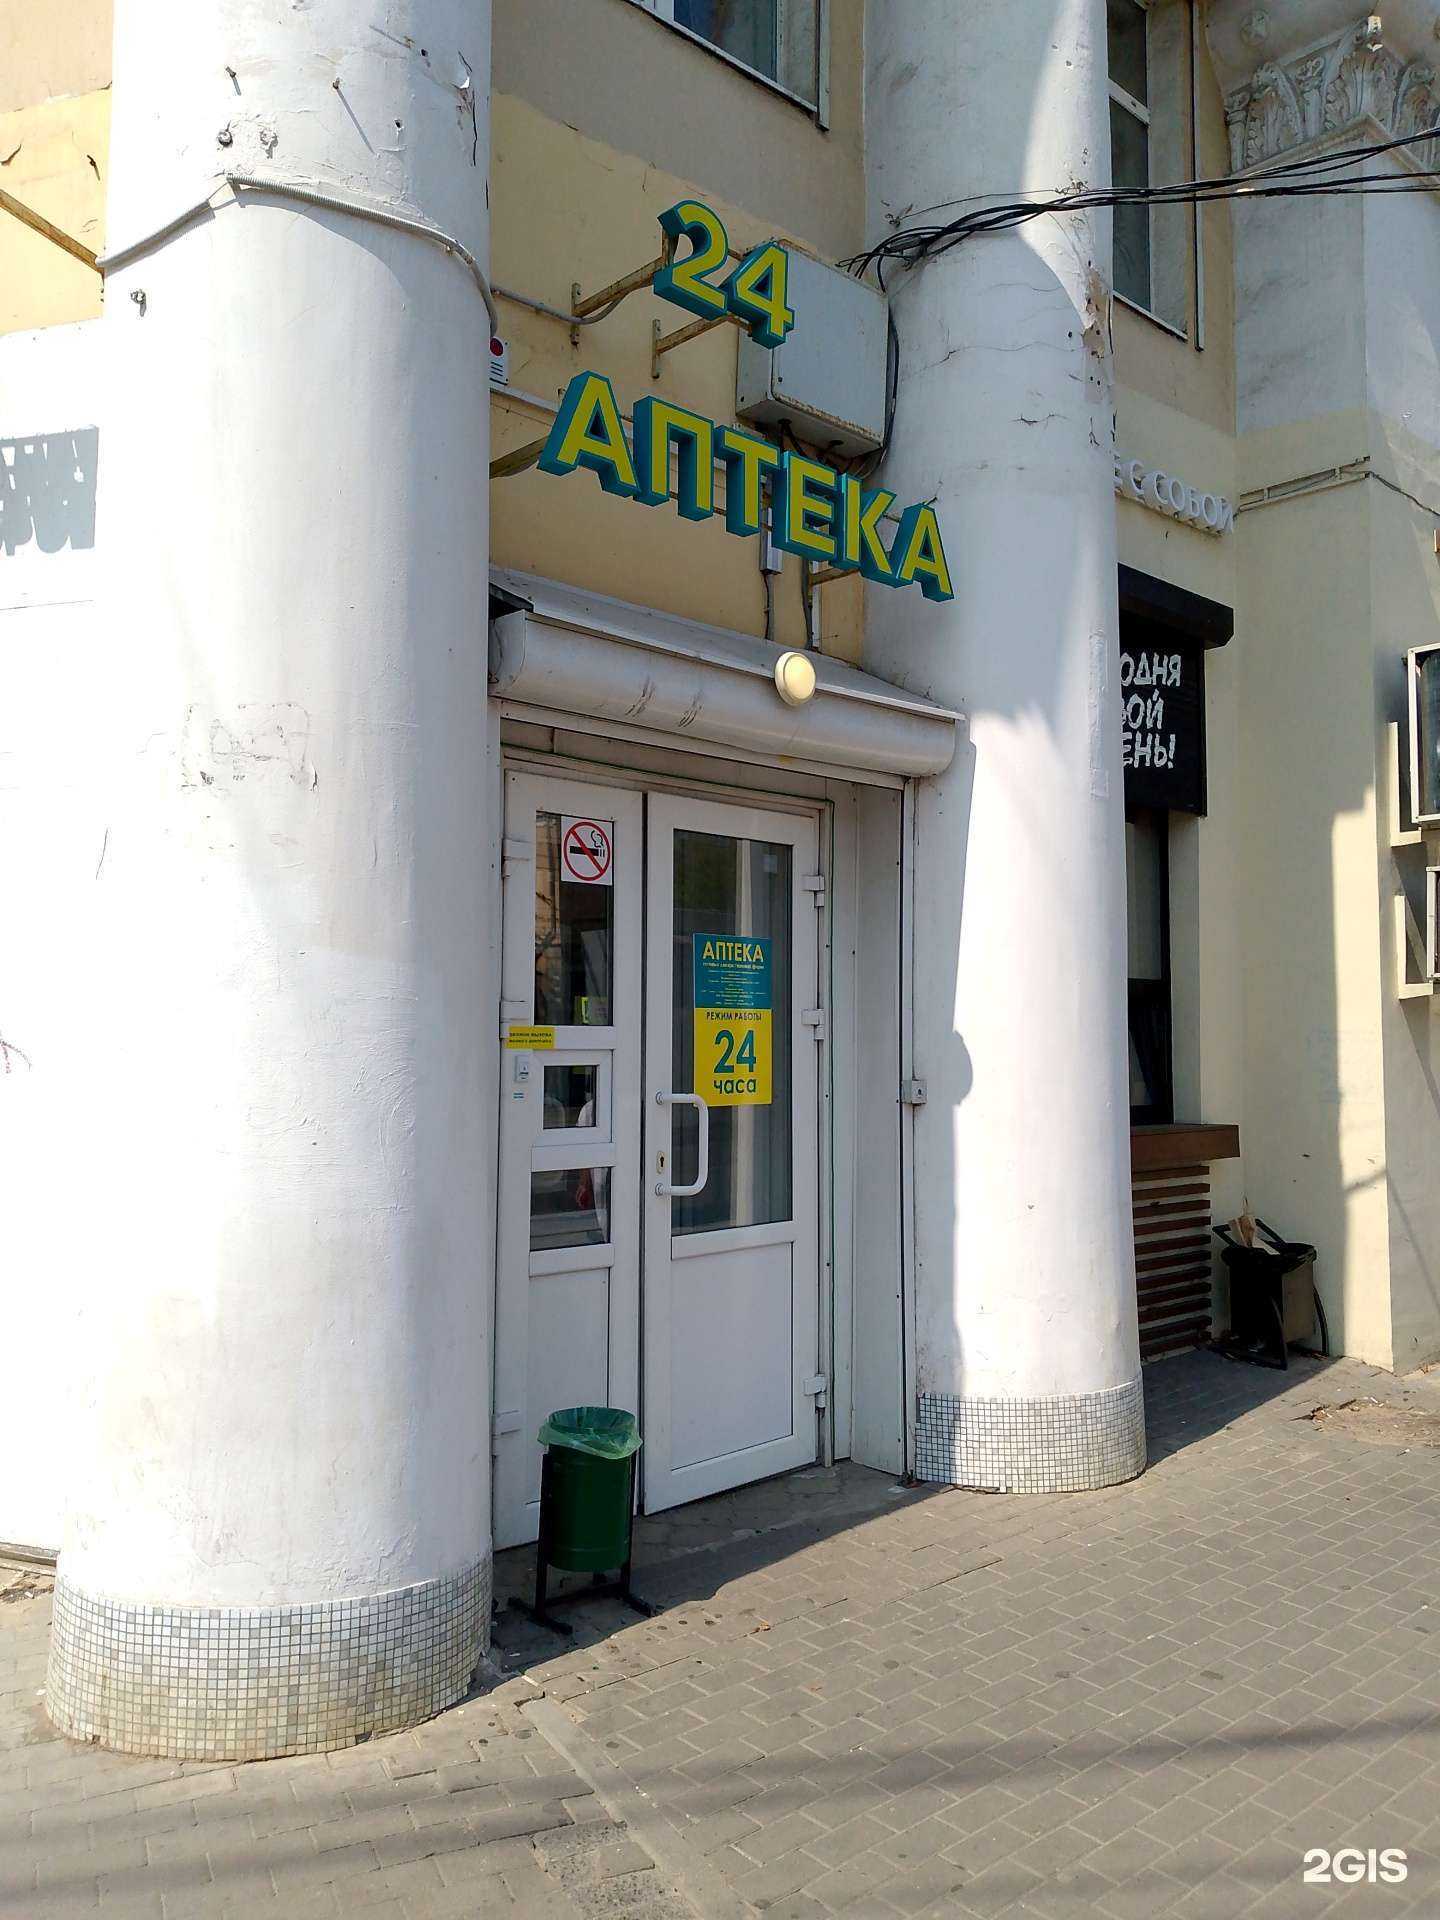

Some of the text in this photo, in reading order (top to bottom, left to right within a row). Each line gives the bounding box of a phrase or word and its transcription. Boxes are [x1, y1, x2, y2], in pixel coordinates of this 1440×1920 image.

[653, 199, 795, 349] 24
[537, 370, 955, 602] АПТЕКА
[702, 941, 764, 963] АПТЕКА
[706, 1011, 762, 1021] РЕЖИМ РАБОТЫ
[713, 1029, 757, 1074] 24
[713, 1078, 757, 1095] часа
